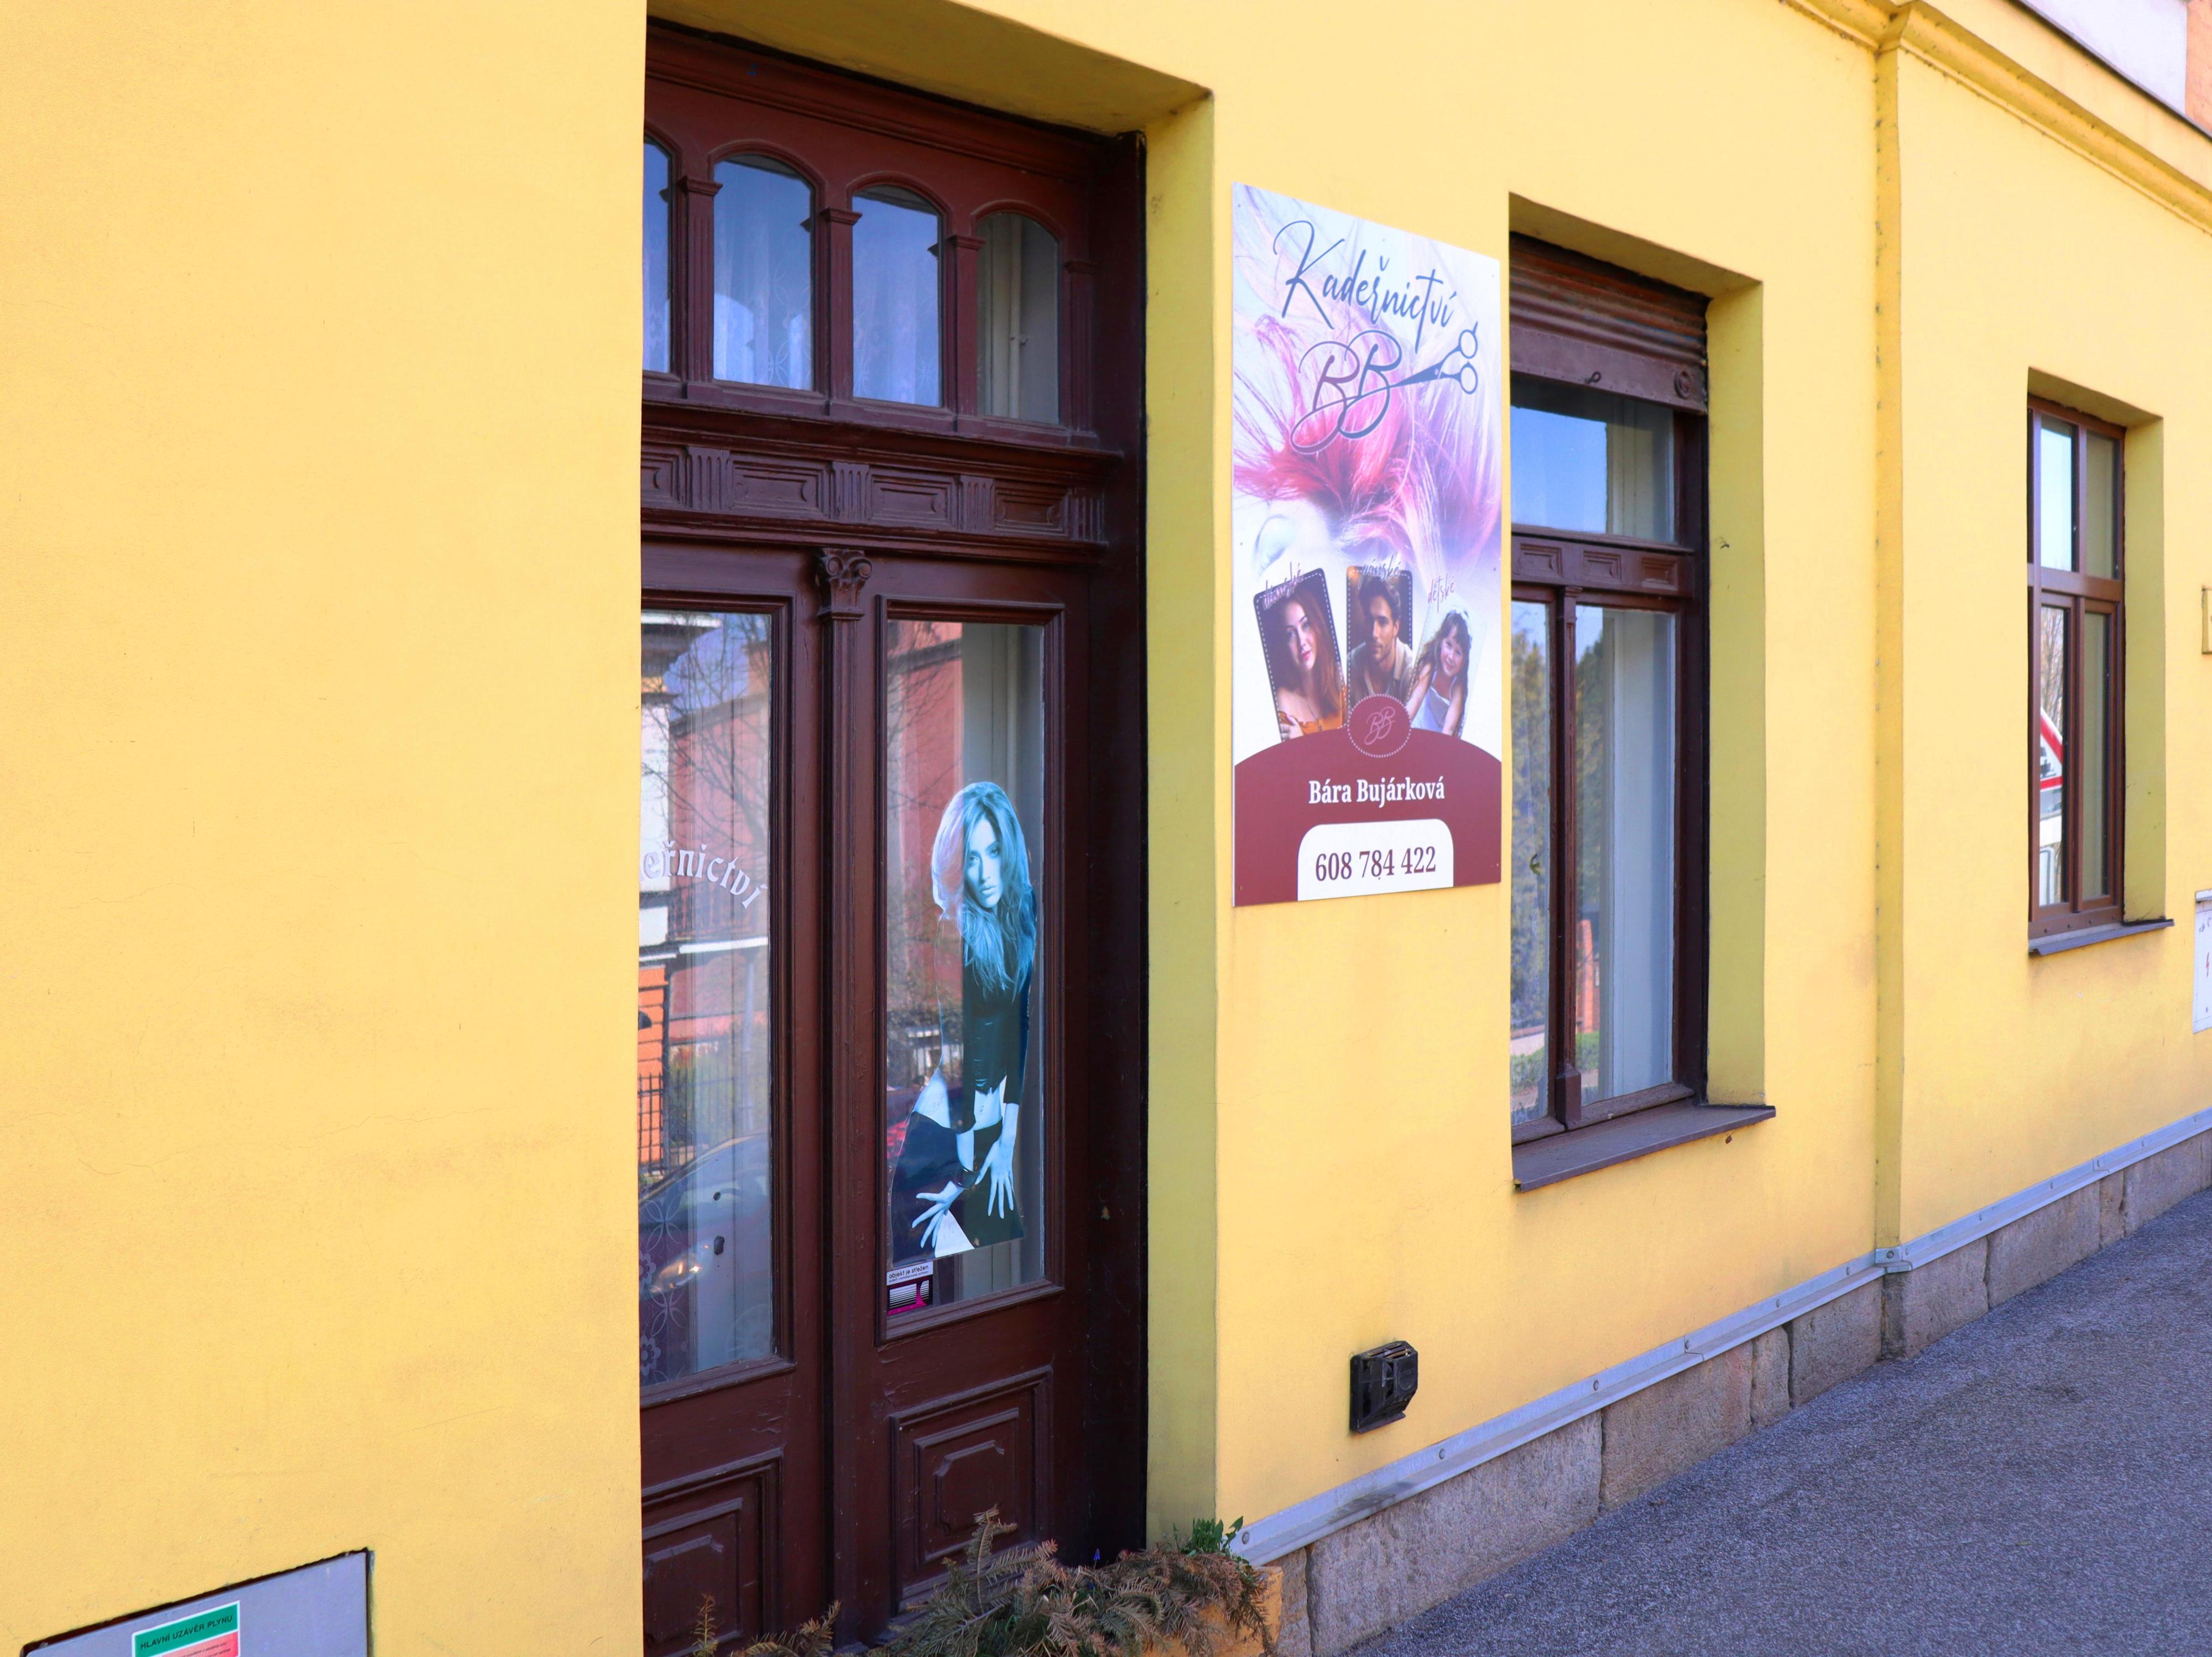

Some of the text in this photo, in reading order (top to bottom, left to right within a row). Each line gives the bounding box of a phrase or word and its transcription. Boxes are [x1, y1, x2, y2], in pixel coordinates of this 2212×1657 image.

[1273, 220, 1457, 354] Kadeřnictví
[1291, 330, 1402, 454] BB
[1308, 776, 1445, 808] Bára Bujárková
[640, 840, 768, 909] eřnictví
[1316, 846, 1436, 881] 608 784 422
[889, 1270, 905, 1279] objekt
[140, 1633, 170, 1650] HLAVNÍ
[207, 1614, 233, 1629] PLYNU
